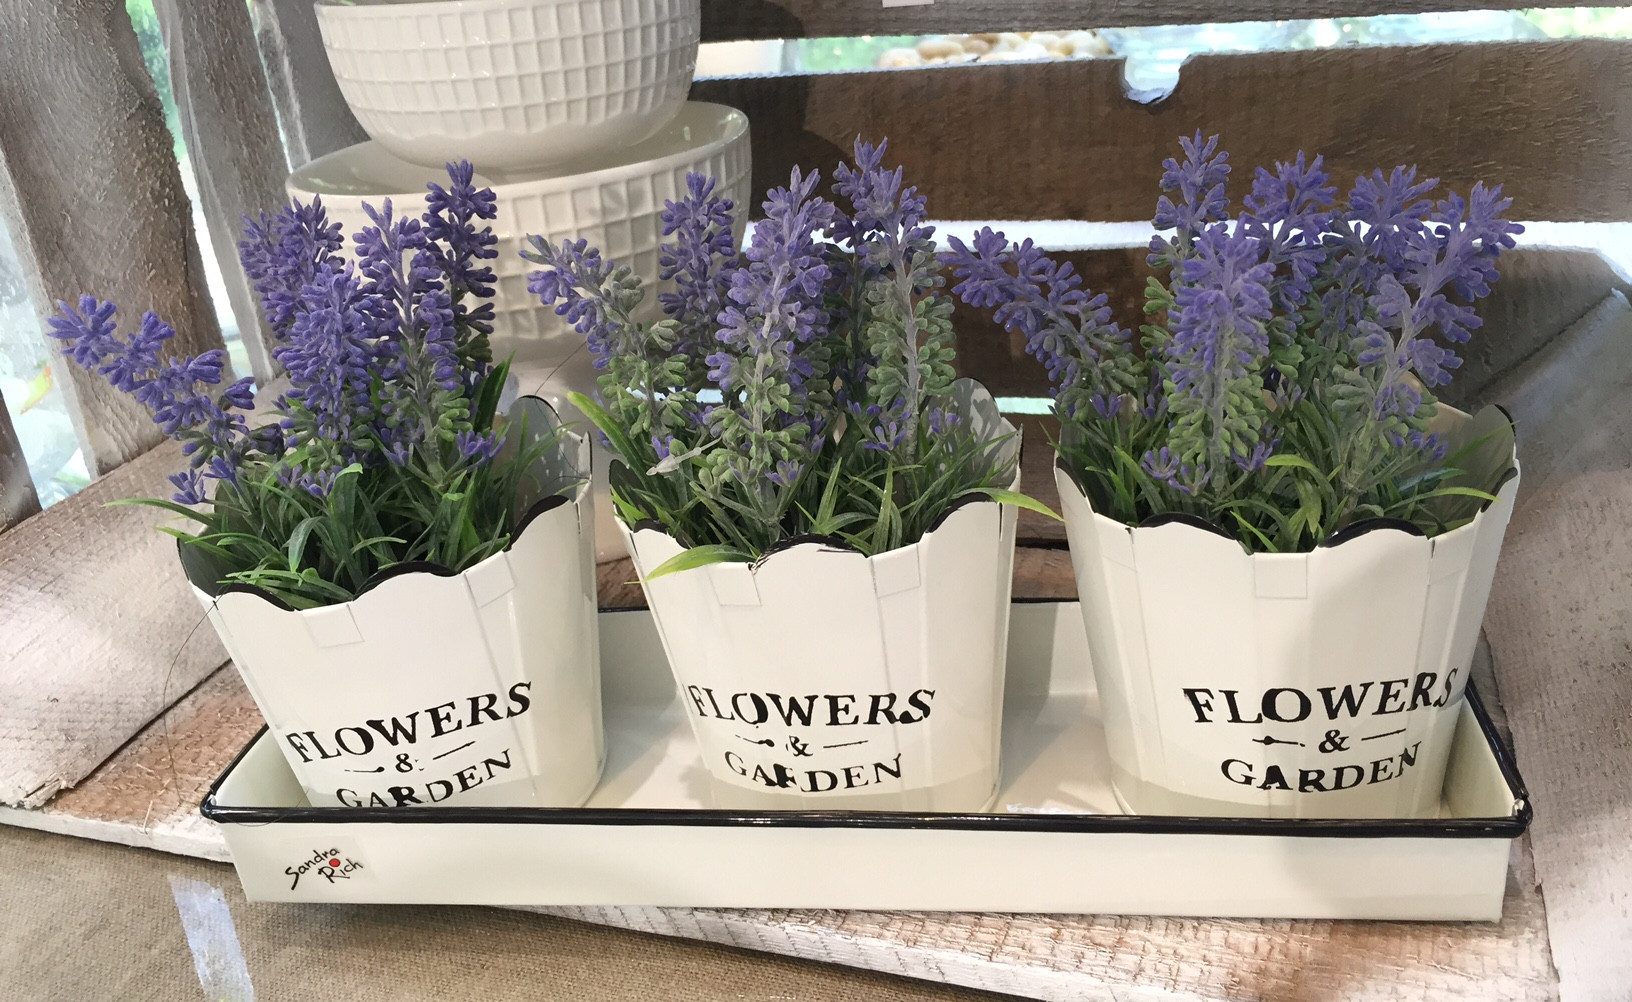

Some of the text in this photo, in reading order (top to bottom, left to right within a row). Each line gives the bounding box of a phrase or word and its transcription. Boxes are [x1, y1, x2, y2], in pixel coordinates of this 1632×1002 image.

[686, 685, 936, 727] FLOWERS
[1182, 667, 1459, 724] FLOWERS
[286, 681, 532, 763] FLOWERS
[1318, 729, 1350, 753] &
[394, 753, 414, 773] &
[786, 735, 814, 757] &
[1220, 741, 1422, 793] GARDEN
[335, 749, 512, 807] GARDEN
[724, 752, 902, 792] GARDEN
[285, 847, 340, 890] Sandra
[317, 858, 364, 884] Rich
